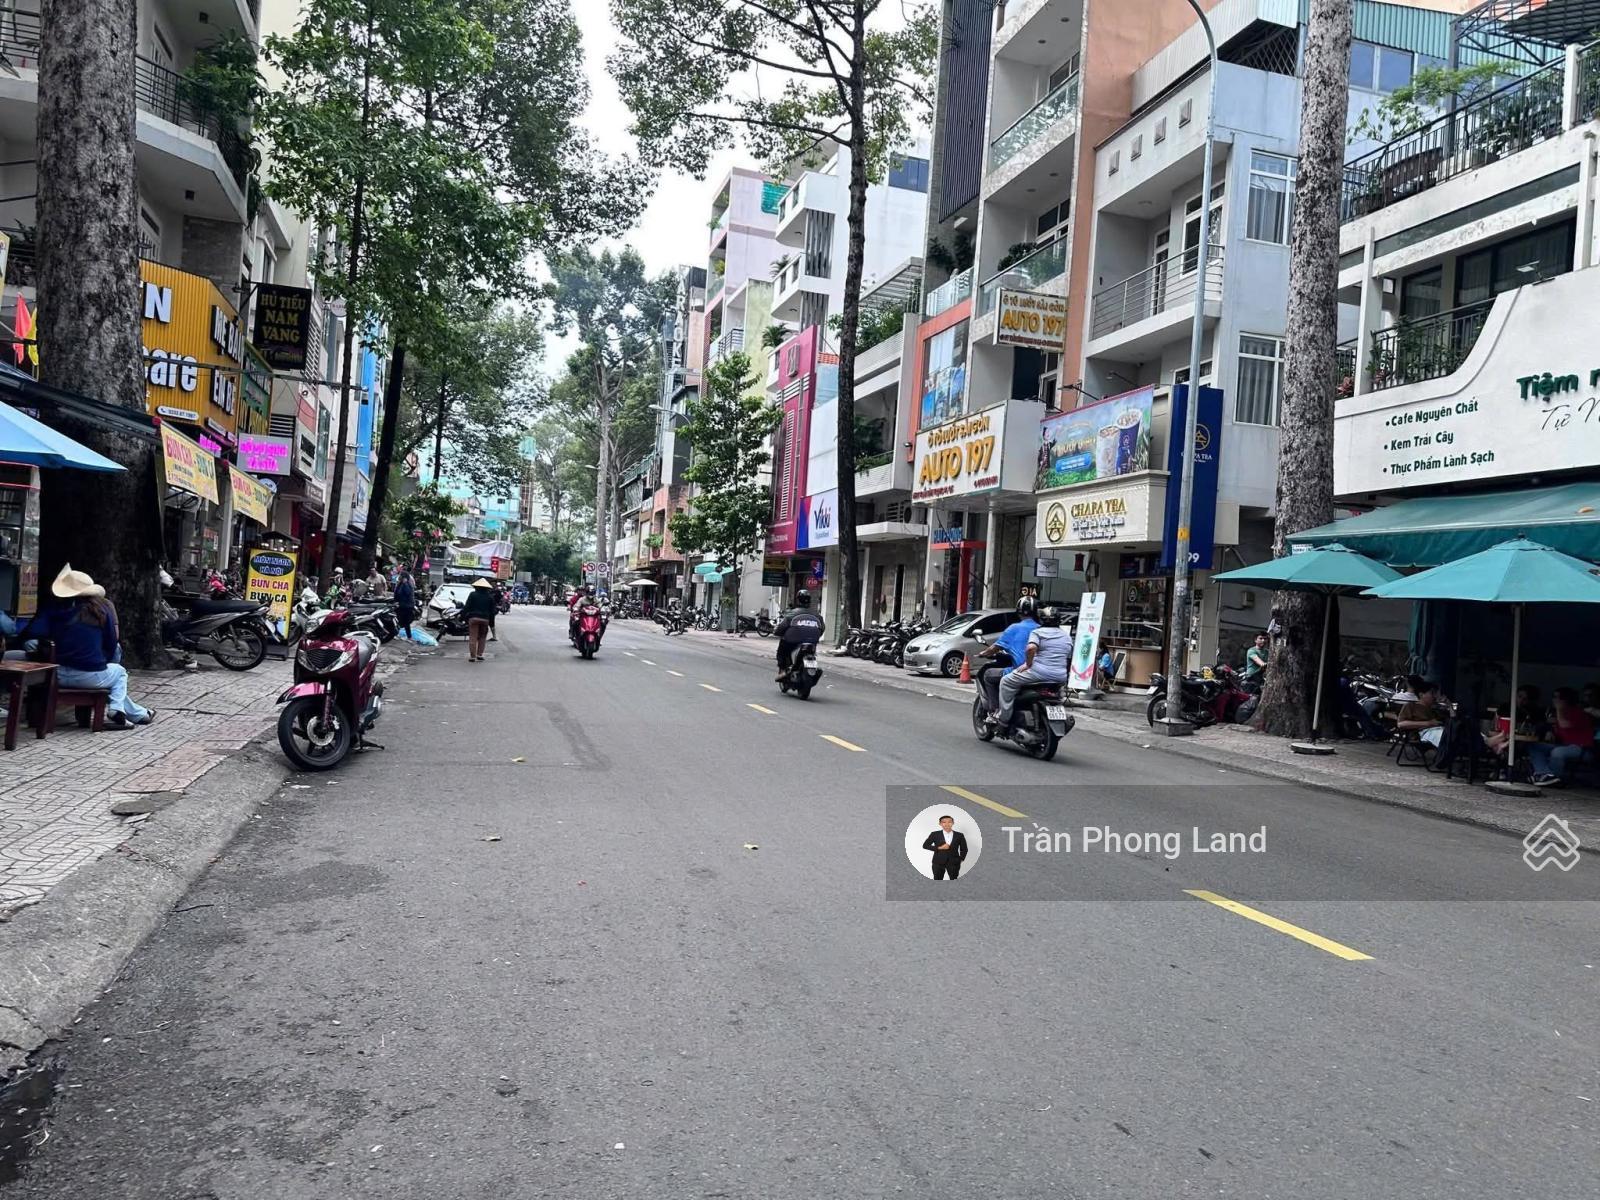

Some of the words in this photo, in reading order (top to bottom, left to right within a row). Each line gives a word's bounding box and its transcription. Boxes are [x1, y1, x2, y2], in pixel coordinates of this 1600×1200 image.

[140, 280, 172, 323] N
[265, 309, 299, 326] NAM
[1001, 308, 1041, 333] AUTO
[1042, 314, 1066, 337] 197
[262, 325, 300, 343] VANG
[1516, 372, 1579, 403] Tiệm
[1391, 413, 1413, 427] Cafe
[1415, 406, 1452, 424] Nguyên
[1455, 396, 1479, 415] Chất
[1391, 439, 1412, 451] Kem
[1413, 432, 1432, 447] Trái
[1435, 431, 1454, 445] Cây
[918, 446, 963, 485] AUTO
[965, 435, 995, 475] 197
[1390, 463, 1412, 476] Thực
[1414, 456, 1441, 471] Phẩm
[1443, 454, 1468, 468] Lành
[1470, 450, 1495, 466] Sạch
[814, 498, 831, 530] Vikki
[1105, 497, 1126, 514] TEA
[272, 580, 289, 591] CHA
